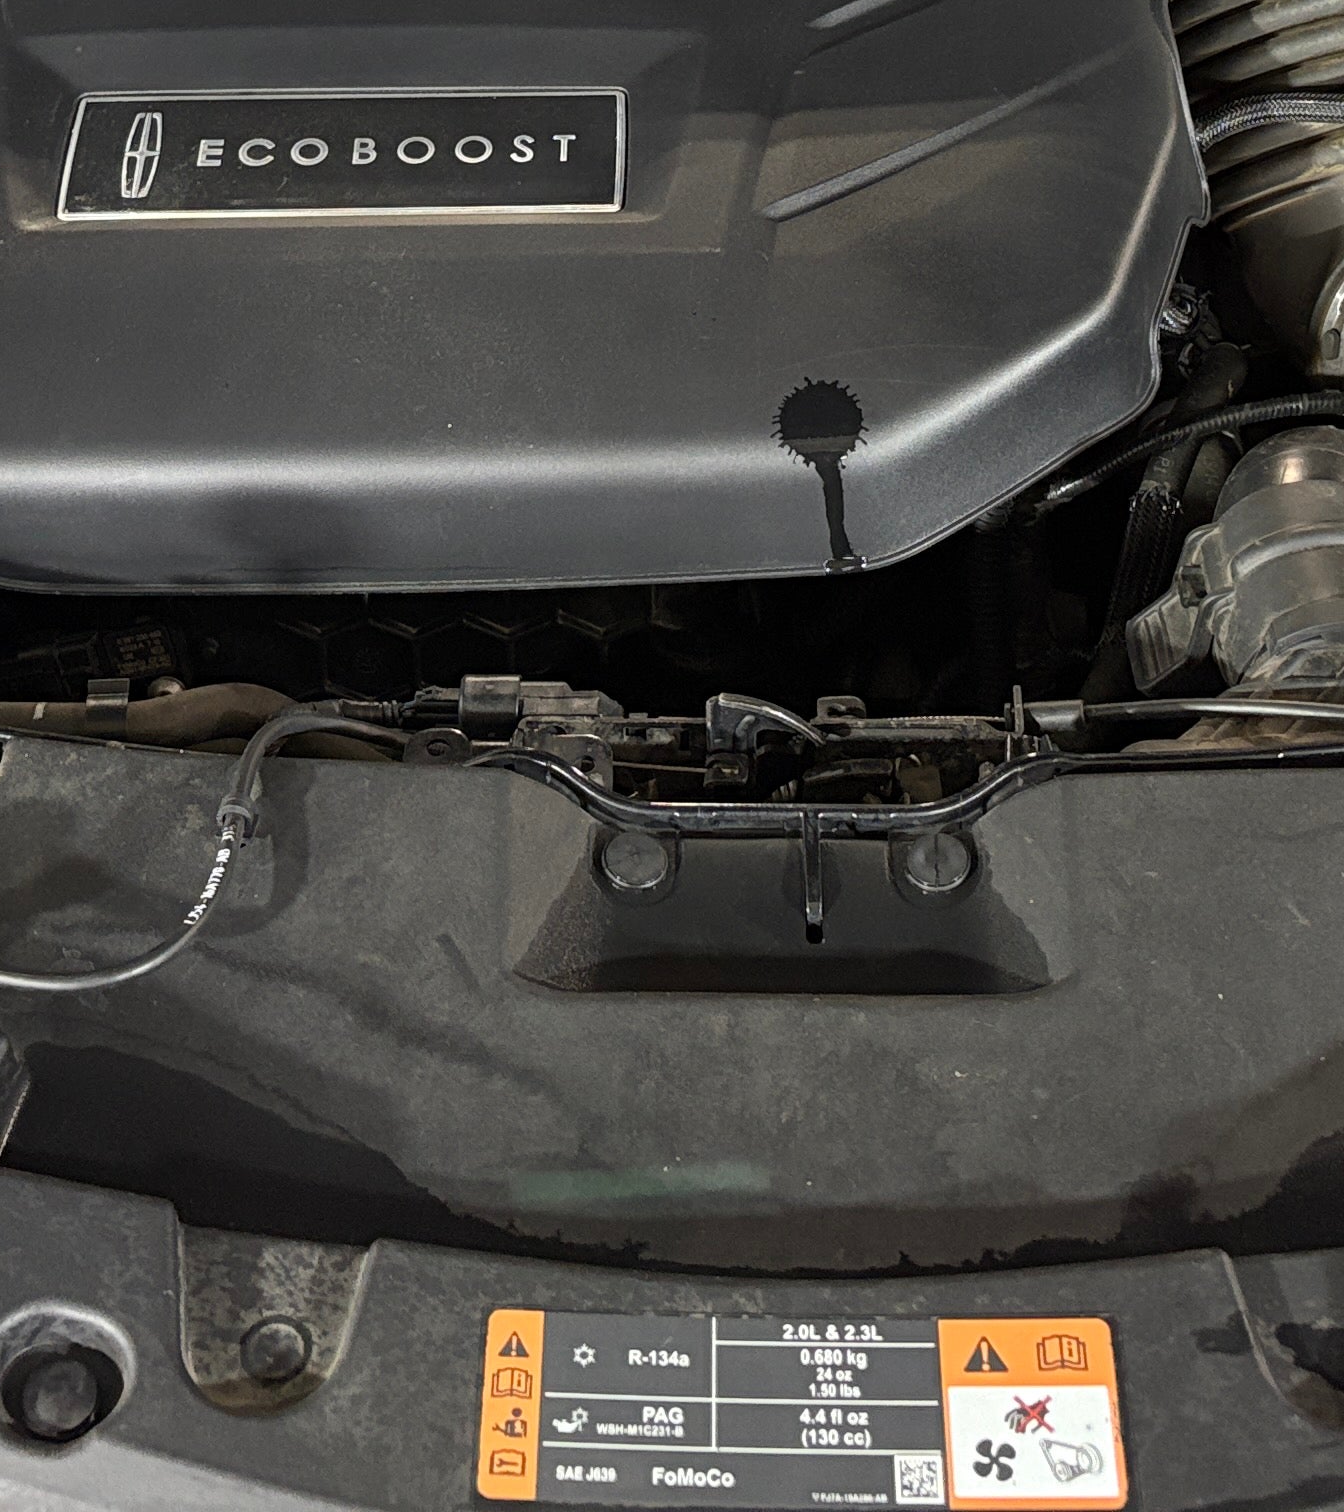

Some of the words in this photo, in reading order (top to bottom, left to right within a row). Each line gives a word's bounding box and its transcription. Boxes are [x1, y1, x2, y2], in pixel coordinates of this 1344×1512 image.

[196, 134, 577, 167] ECOBOOST
[782, 1324, 822, 1341] 2.0L
[825, 1325, 841, 1340] &
[843, 1325, 884, 1341] 2.3L
[628, 1349, 691, 1368] R-134a
[800, 1349, 844, 1366] 0.680
[846, 1350, 869, 1370] kg
[815, 1367, 833, 1381] 24
[835, 1370, 853, 1382] oz
[808, 1383, 837, 1398] 1.50
[839, 1384, 862, 1398] lbs
[642, 1406, 685, 1424] PAG
[799, 1408, 827, 1426] 4.4
[830, 1409, 843, 1426] fl
[846, 1413, 870, 1426] oz
[800, 1428, 840, 1447] (130
[843, 1429, 872, 1449] cc)
[555, 1464, 584, 1482] SAE
[586, 1466, 618, 1483] J639
[652, 1466, 736, 1488] FoMoCo
